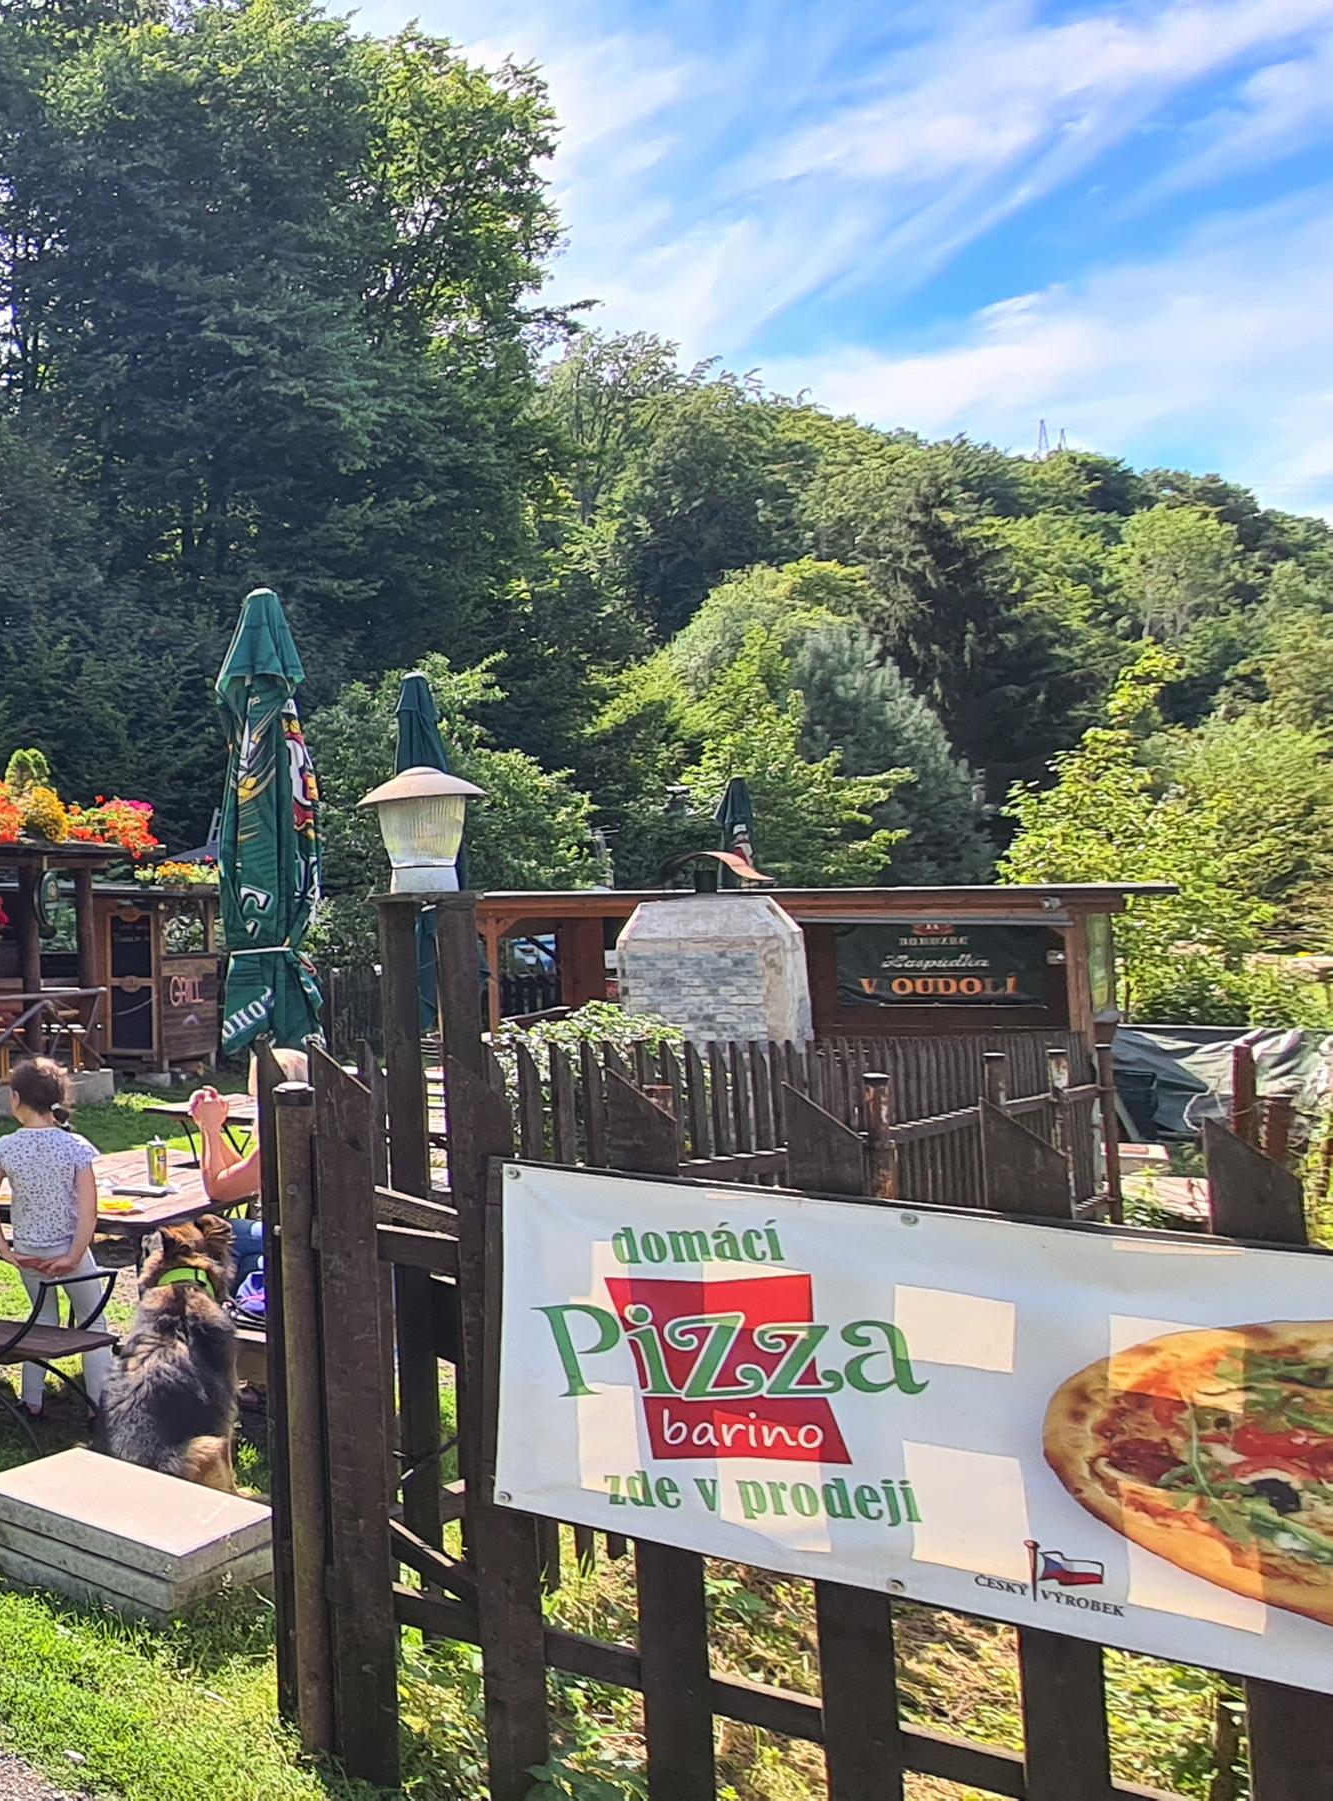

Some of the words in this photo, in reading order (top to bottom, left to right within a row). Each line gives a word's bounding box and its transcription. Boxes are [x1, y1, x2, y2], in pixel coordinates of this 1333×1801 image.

[858, 976, 880, 995] V
[611, 1219, 785, 1265] domácí
[530, 1303, 931, 1399] Pizza
[662, 1408, 825, 1450] barino
[603, 1470, 681, 1509] zde
[693, 1478, 719, 1512] v
[735, 1477, 924, 1527] prodeji
[1040, 1589, 1126, 1618] VÝROBEK
